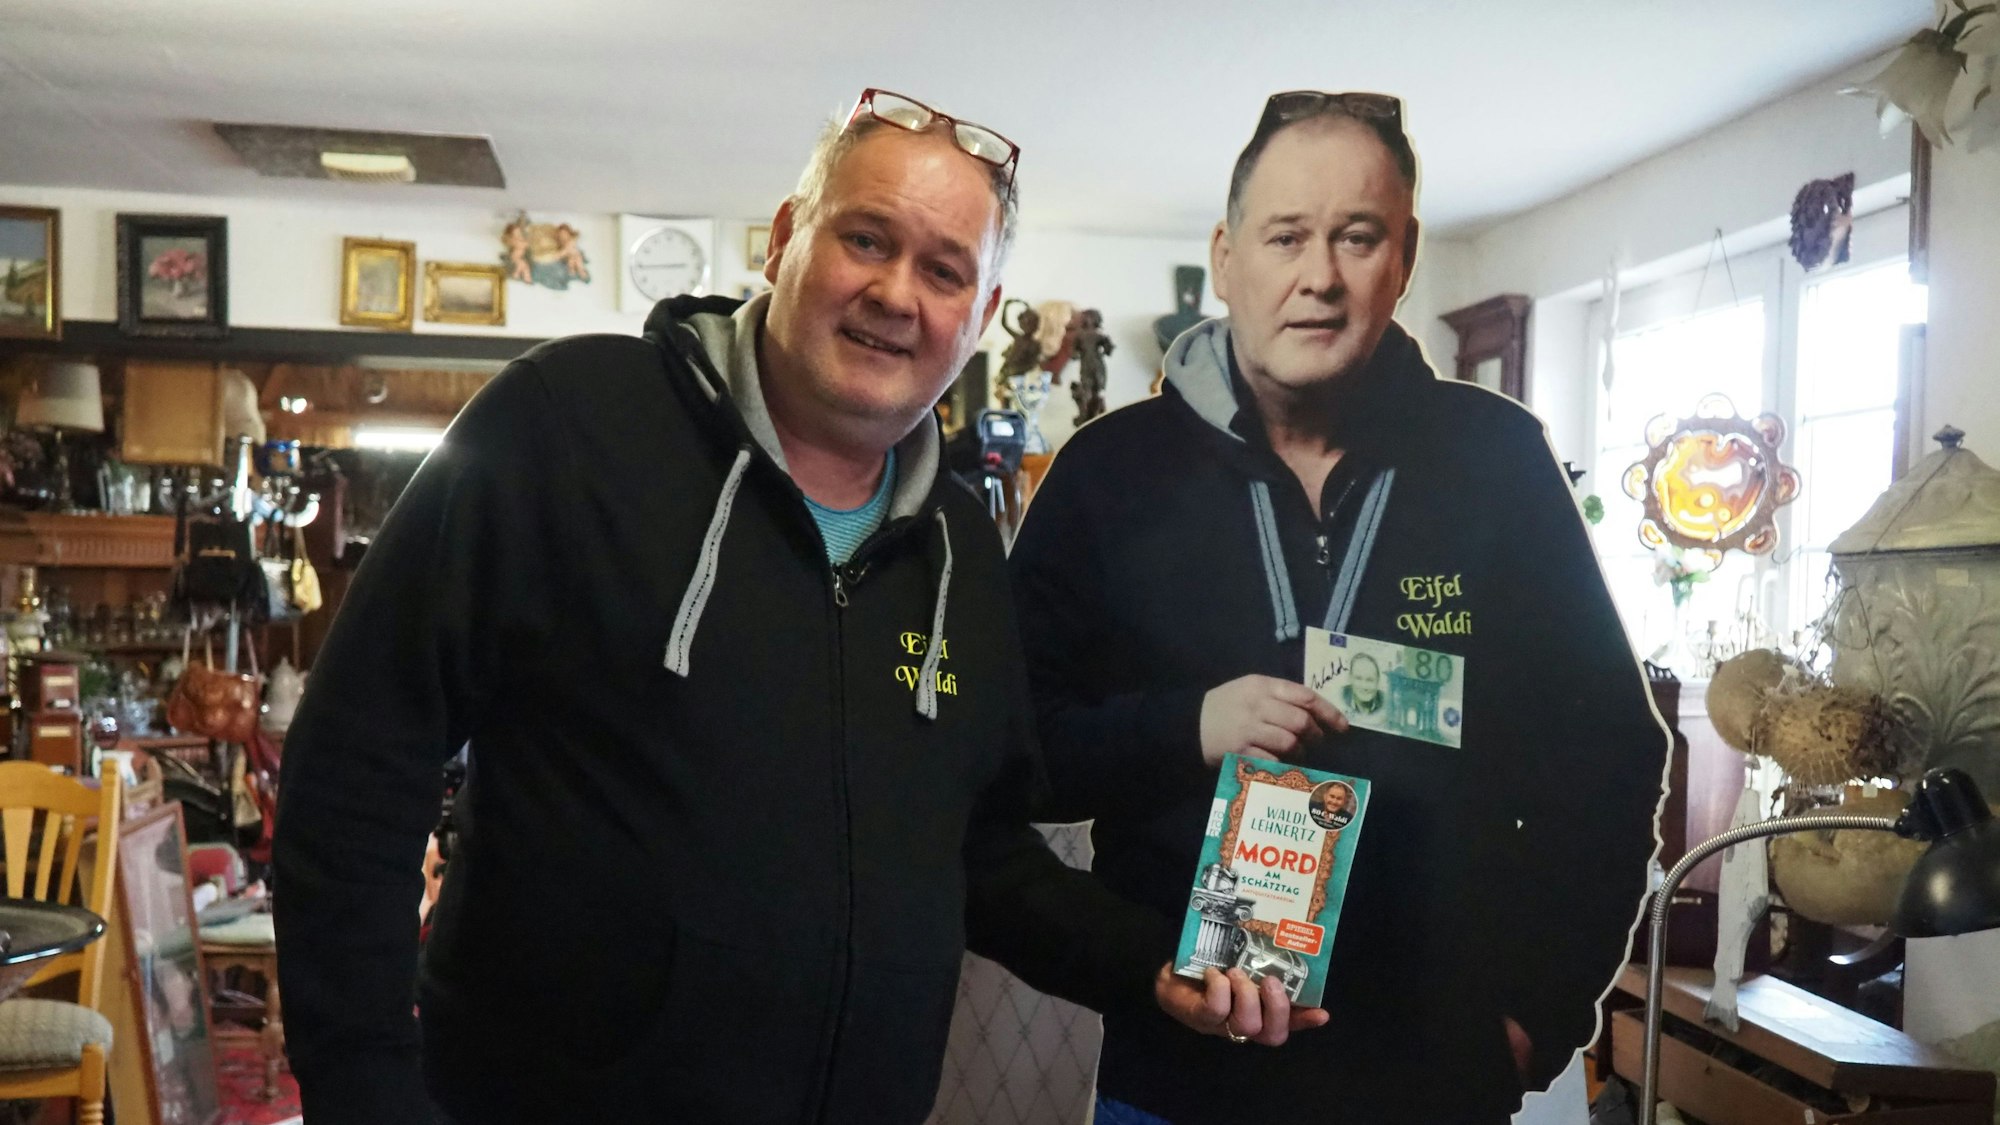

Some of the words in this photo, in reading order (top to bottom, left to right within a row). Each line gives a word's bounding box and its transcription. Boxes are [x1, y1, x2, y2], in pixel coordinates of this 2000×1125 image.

[1400, 574, 1463, 608] Eifel
[1397, 611, 1472, 639] Waldi
[900, 632, 949, 659] Eil
[895, 665, 957, 695] Wldi
[1415, 650, 1453, 683] 80
[1267, 806, 1307, 826] WALDI
[1251, 818, 1315, 842] LEHNERTZ
[1235, 840, 1317, 875] MORD
[1241, 876, 1300, 896] SCHÄTZTAG
[1265, 871, 1281, 880] AM
